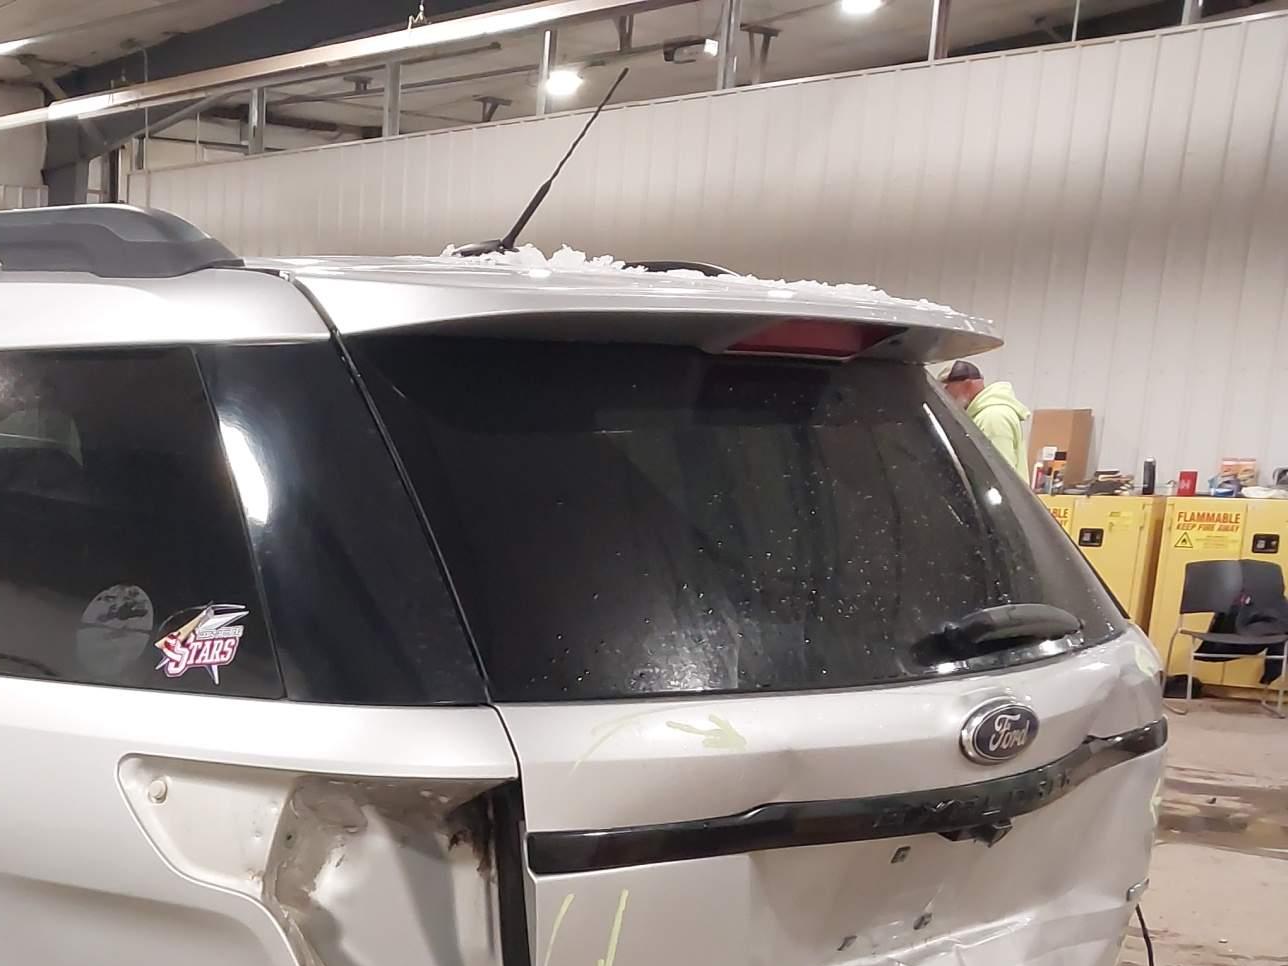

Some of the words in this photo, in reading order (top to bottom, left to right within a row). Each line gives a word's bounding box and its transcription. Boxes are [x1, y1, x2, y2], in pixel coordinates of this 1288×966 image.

[1176, 522, 1196, 531] KEEP
[1217, 524, 1240, 533] AWAY
[1177, 511, 1240, 524] FLAMMABLE
[163, 635, 240, 676] STARS
[989, 713, 1030, 752] Ford
